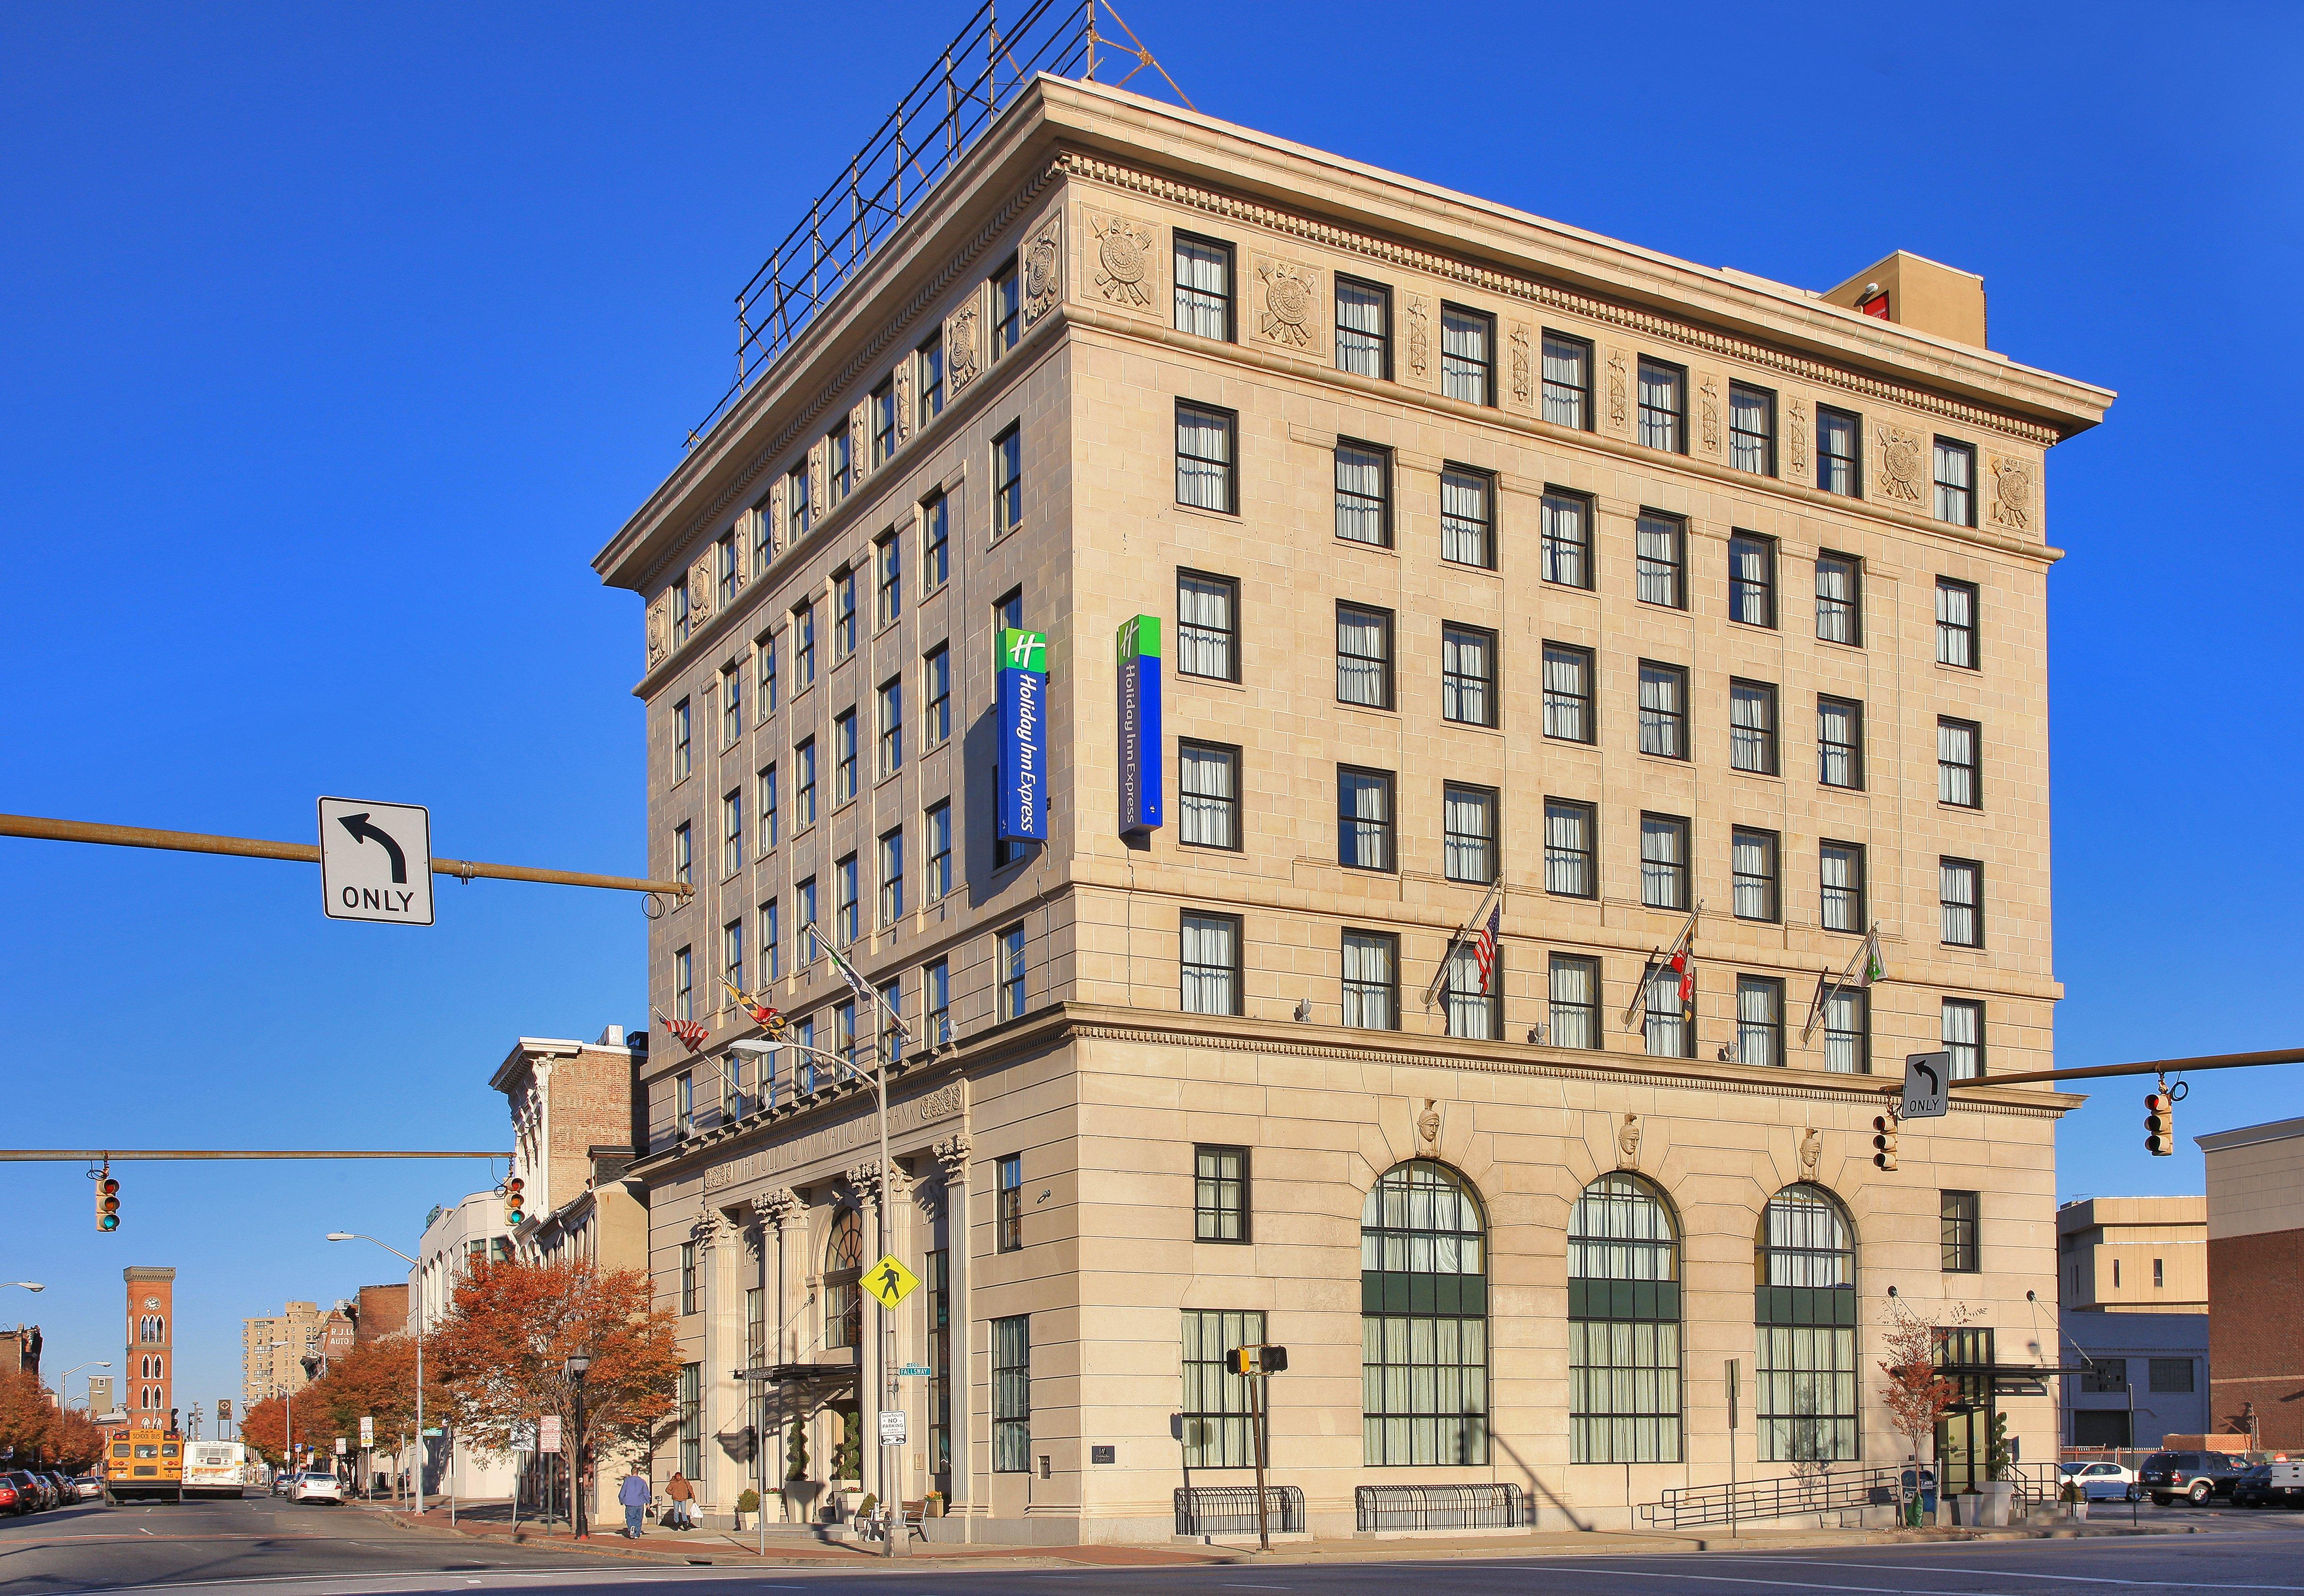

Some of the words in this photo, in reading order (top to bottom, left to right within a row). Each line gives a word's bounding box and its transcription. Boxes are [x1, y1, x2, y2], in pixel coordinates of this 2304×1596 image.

[1016, 673, 1037, 742] Holiday
[1125, 664, 1135, 731] Holiday
[1020, 742, 1037, 771] Inn
[1127, 733, 1136, 761] Inn
[1017, 771, 1036, 833] Express
[1125, 763, 1135, 823] Express
[342, 886, 415, 913] ONLY
[1910, 1098, 1940, 1112] ONLY
[739, 1155, 754, 1179] THE
[759, 1147, 779, 1172] OLD
[781, 1135, 816, 1165] TOWN
[822, 1112, 880, 1154] NATIONAL
